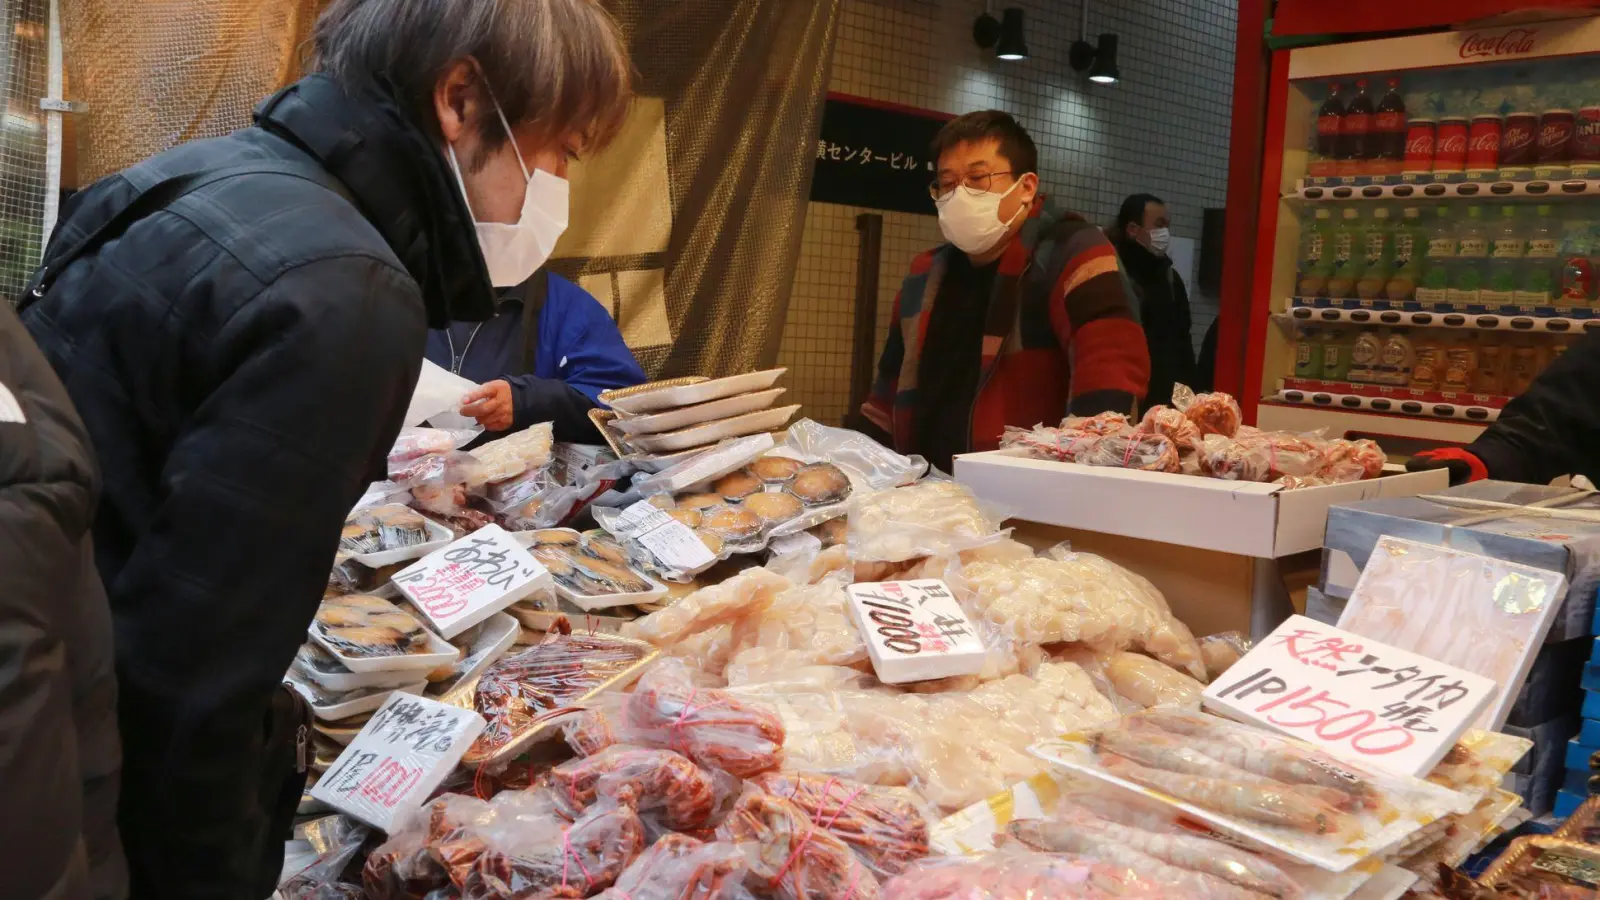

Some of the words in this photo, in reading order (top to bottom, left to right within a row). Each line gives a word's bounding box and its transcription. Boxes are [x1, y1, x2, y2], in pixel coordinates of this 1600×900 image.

[1459, 28, 1540, 59] Coca-Cola
[444, 537, 534, 590] あわび
[409, 577, 468, 618] 2000
[1217, 668, 1288, 700] 1P
[1255, 686, 1416, 756] 1500
